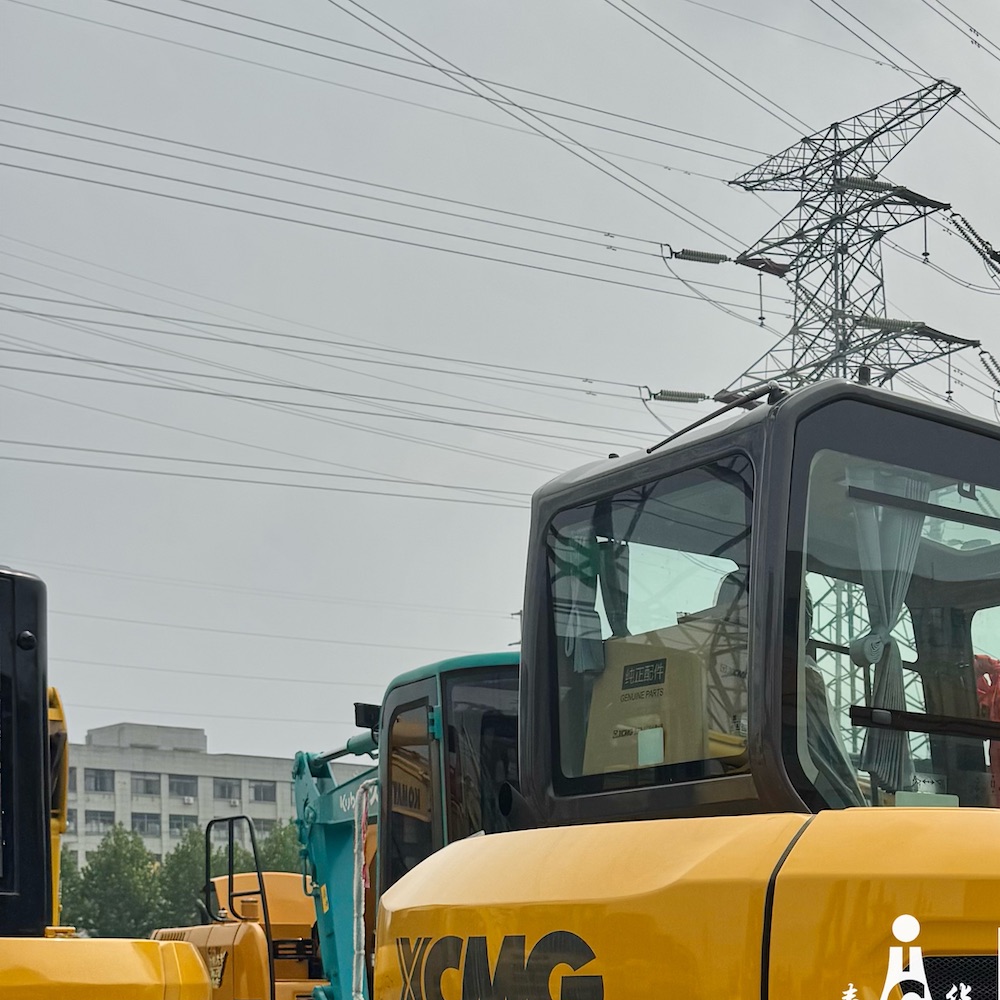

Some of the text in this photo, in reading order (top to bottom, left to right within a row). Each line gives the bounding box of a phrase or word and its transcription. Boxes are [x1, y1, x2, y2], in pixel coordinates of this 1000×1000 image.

[624, 661, 664, 685] 纯正配件
[620, 688, 664, 702] GENUINE PARTS
